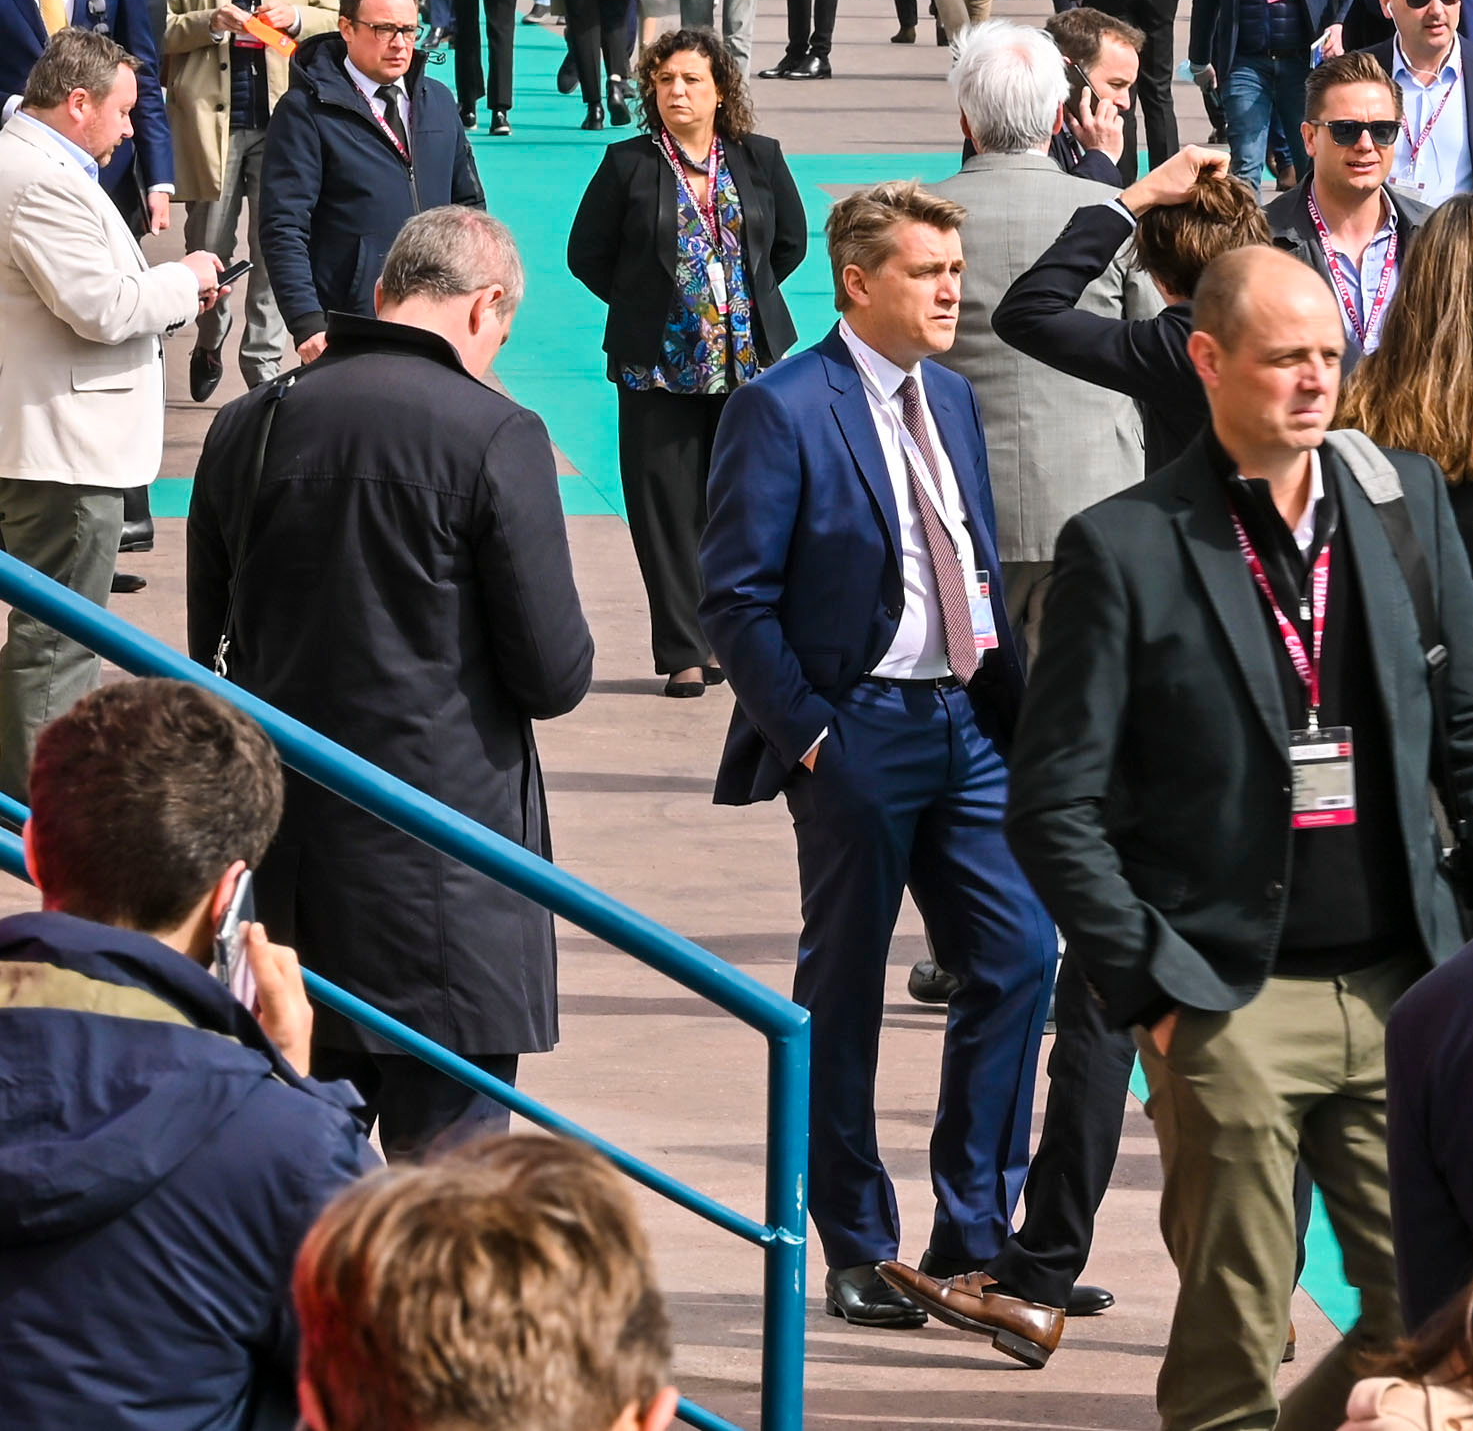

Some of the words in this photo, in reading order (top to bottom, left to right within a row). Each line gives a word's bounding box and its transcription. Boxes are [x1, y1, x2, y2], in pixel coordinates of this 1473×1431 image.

[1319, 230, 1335, 263] CATELLA
[1332, 268, 1348, 301] CATELLA
[1377, 266, 1392, 299] CATELLA
[1312, 566, 1329, 618] CATELLA
[1284, 635, 1312, 686] CATELLA
